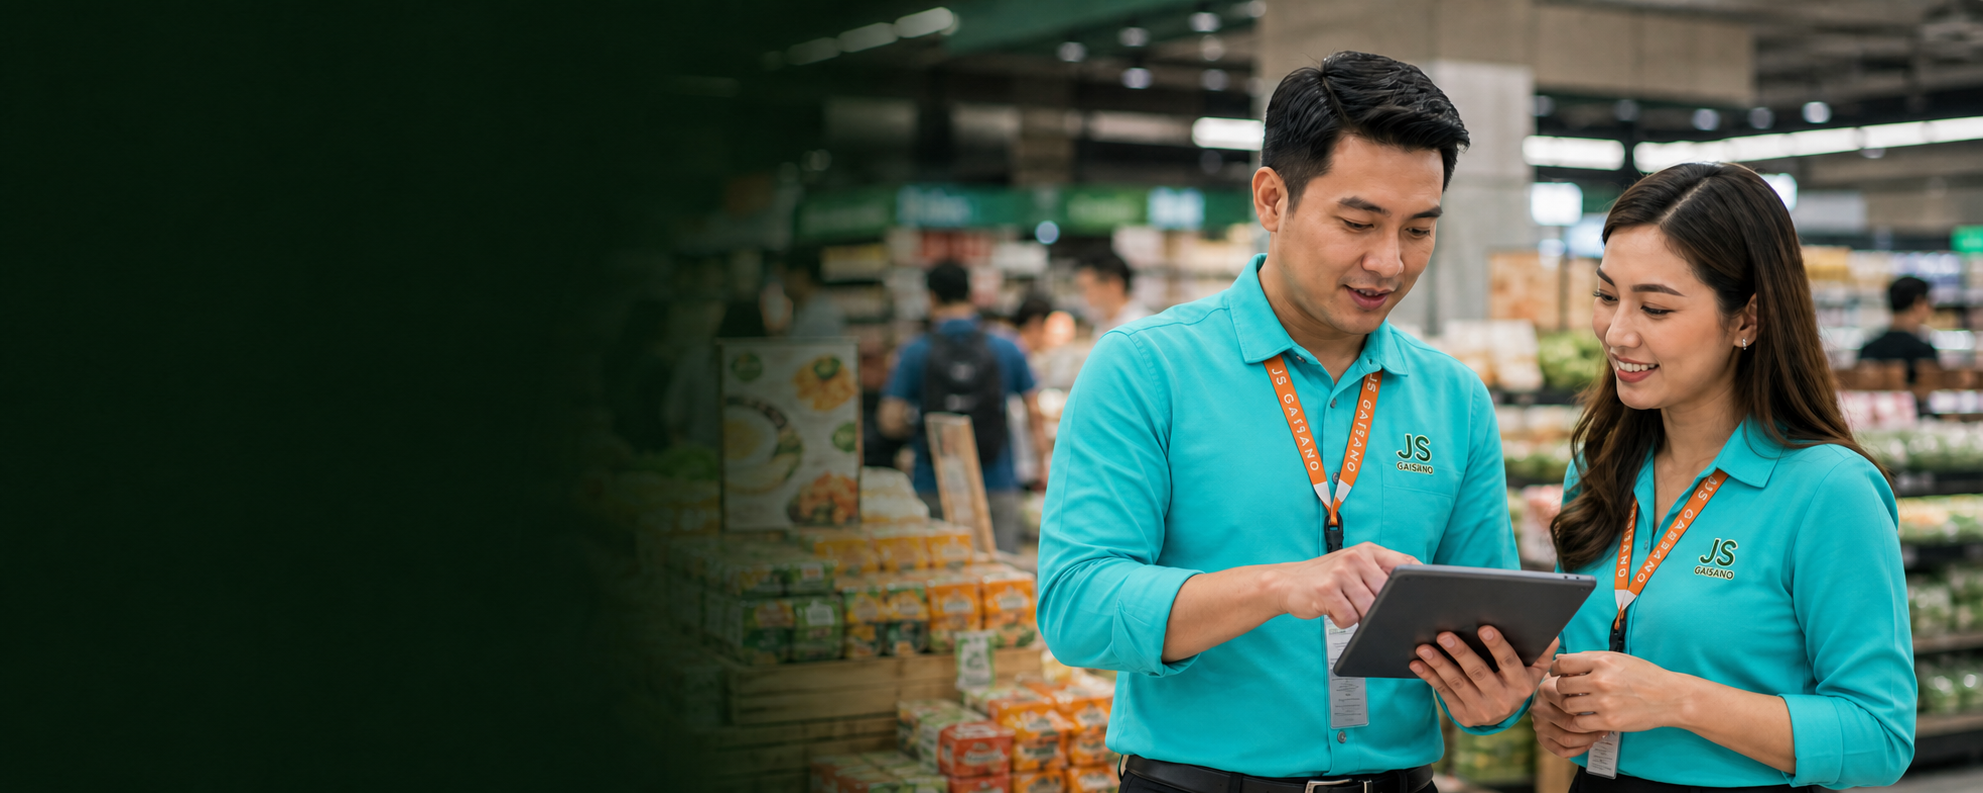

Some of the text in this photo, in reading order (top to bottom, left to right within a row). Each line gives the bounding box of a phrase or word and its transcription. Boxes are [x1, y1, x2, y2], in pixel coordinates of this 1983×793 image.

[1271, 368, 1287, 386] JS
[1366, 373, 1378, 393] JS
[1396, 433, 1432, 463] JS
[1699, 537, 1739, 568] JS
